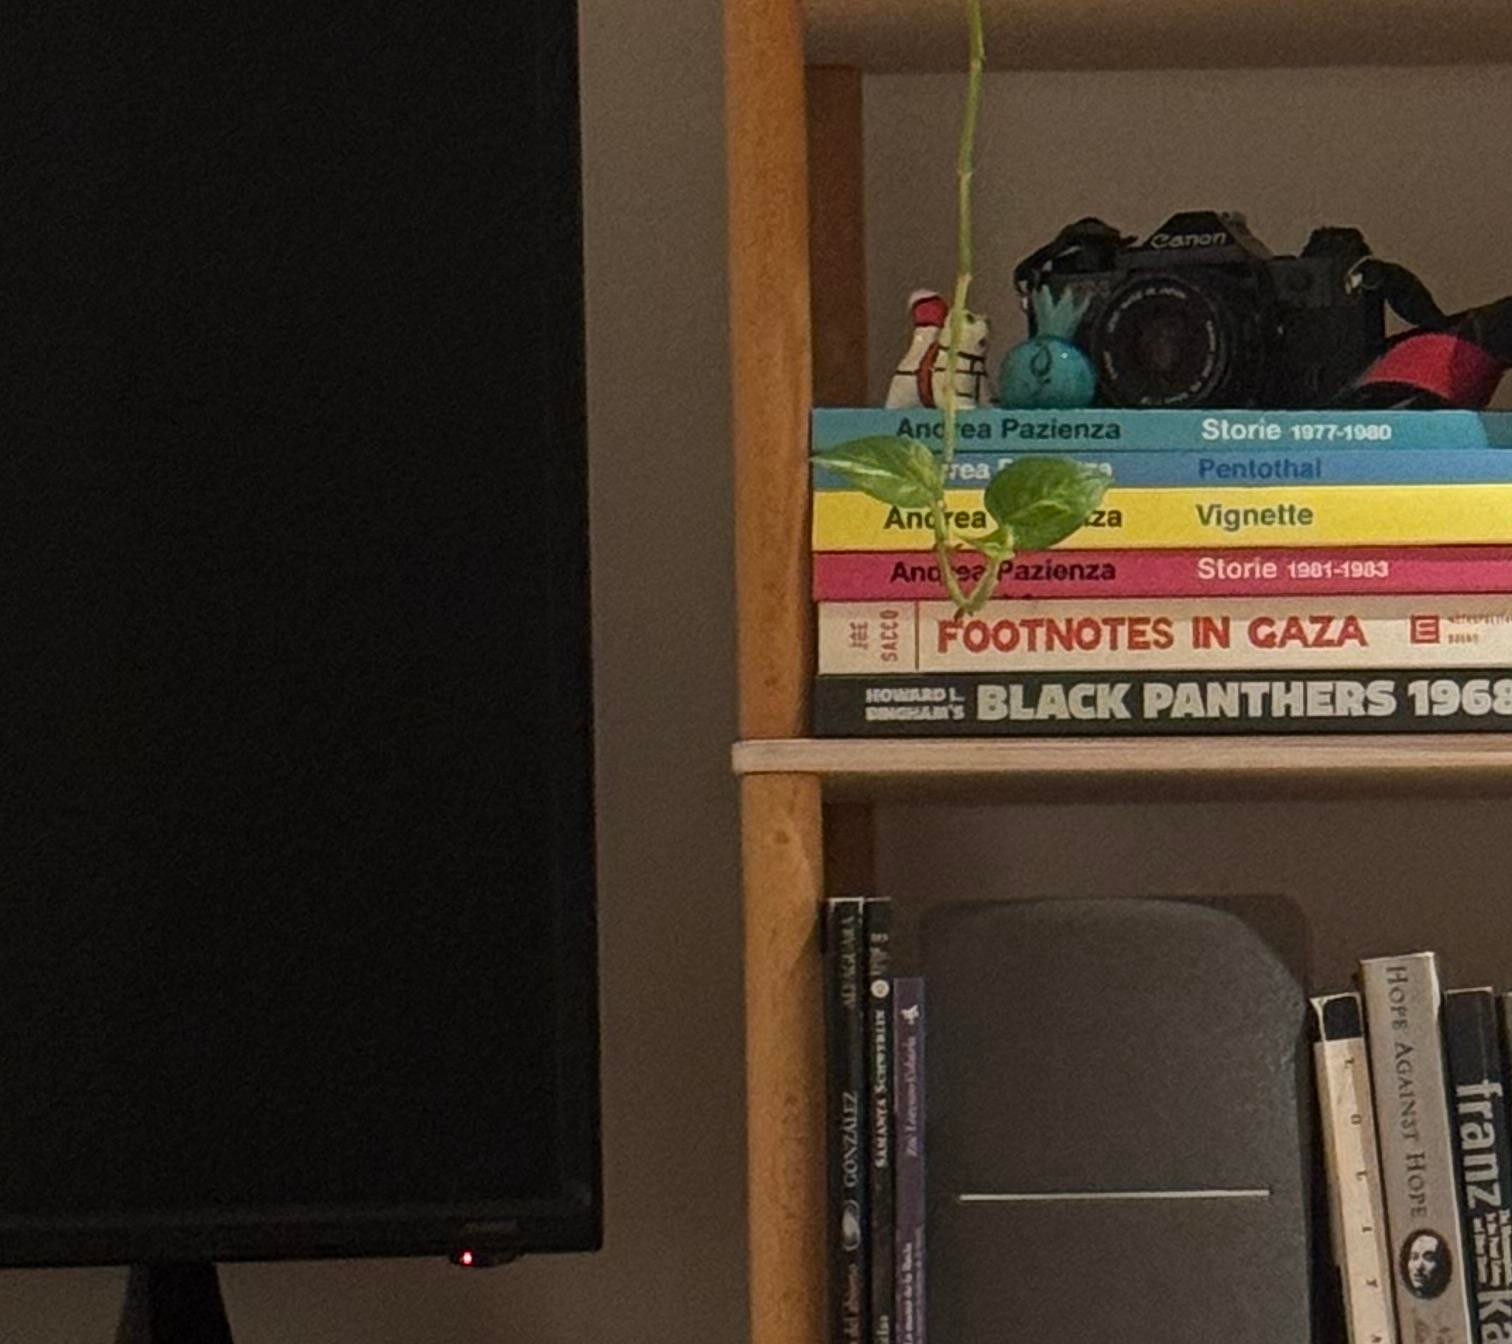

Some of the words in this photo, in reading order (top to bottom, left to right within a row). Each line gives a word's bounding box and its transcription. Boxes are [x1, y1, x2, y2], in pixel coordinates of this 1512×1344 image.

[1150, 231, 1226, 249] Canon
[1001, 418, 1121, 440] Pazienza
[1202, 419, 1283, 442] Storie
[1291, 423, 1392, 442] 1977-1980
[1199, 456, 1323, 480] Pentothal
[1196, 502, 1313, 528] Vignette
[1000, 557, 1117, 581] Pazienza
[1197, 557, 1279, 580] Storie
[1287, 560, 1389, 579] 1981-1983
[937, 615, 1174, 653] FOOTNOTES
[1192, 616, 1231, 649] IN
[1248, 614, 1369, 648] GAZA
[976, 681, 1132, 721] BLACK
[1142, 681, 1396, 718] PANTHERS
[1386, 966, 1411, 1030] HOPE
[1395, 1042, 1421, 1146] AGAINST
[1455, 1081, 1504, 1208] franz
[1405, 1153, 1429, 1217] HOPE
